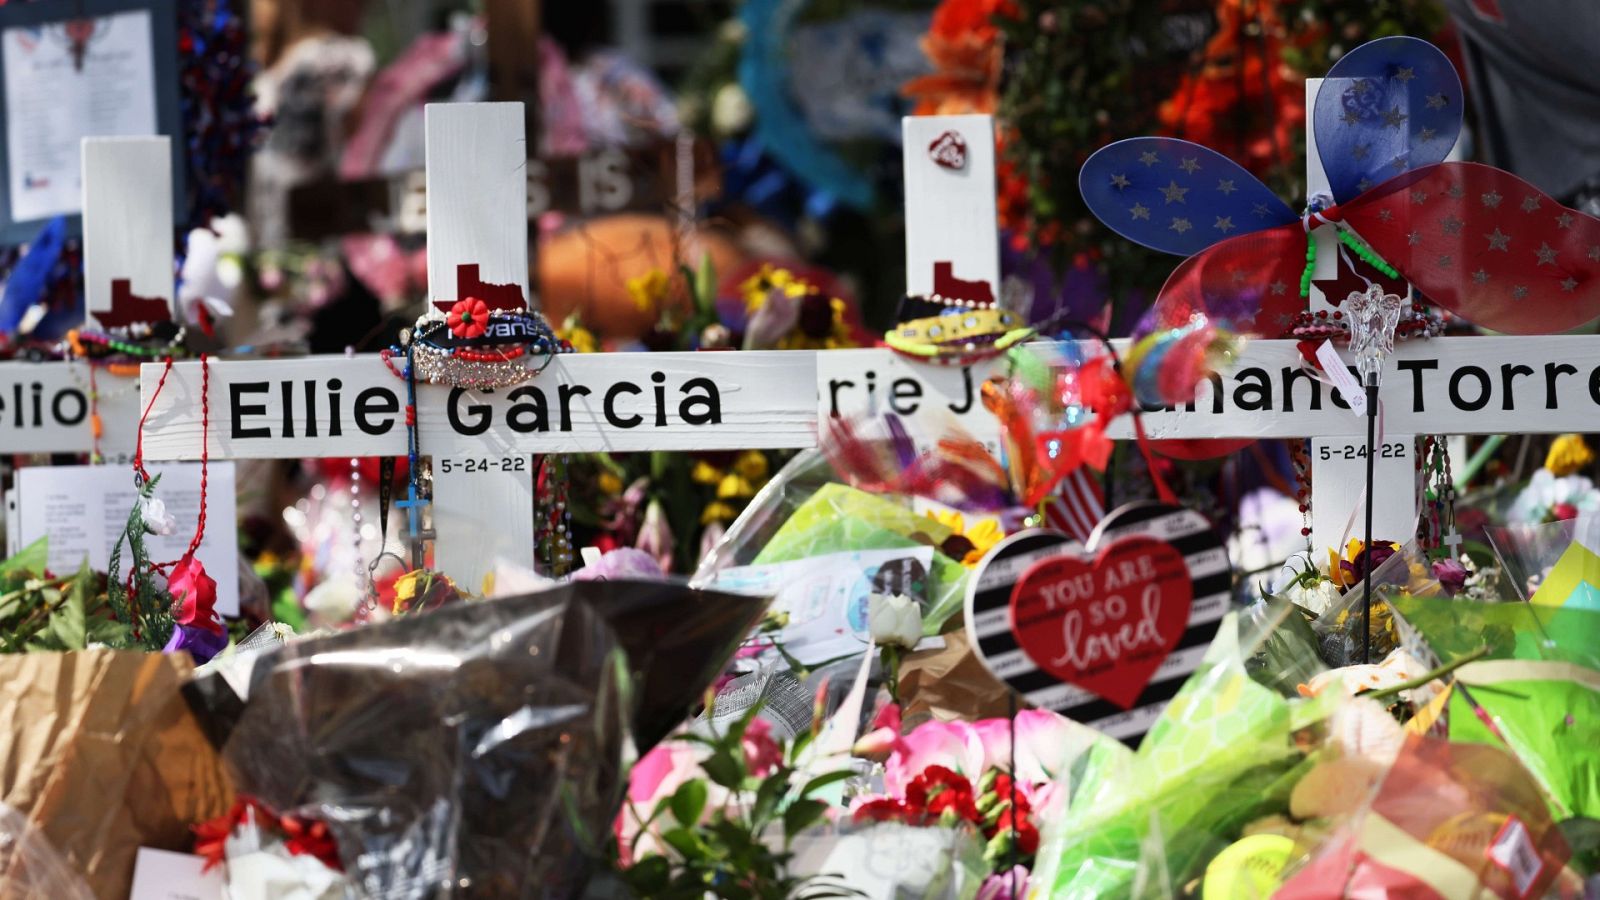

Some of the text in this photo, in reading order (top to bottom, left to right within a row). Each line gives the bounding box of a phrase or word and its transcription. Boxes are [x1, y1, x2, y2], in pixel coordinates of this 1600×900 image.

[0, 381, 88, 429] lio
[228, 370, 723, 439] Ellie Garcia
[817, 370, 923, 418] rie
[1397, 358, 1600, 413] Torr
[440, 457, 526, 474] 5-24-22
[1039, 571, 1095, 609] YOU
[1103, 554, 1157, 592] ARE
[1052, 583, 1167, 670] loved
[1088, 595, 1128, 626] SO
